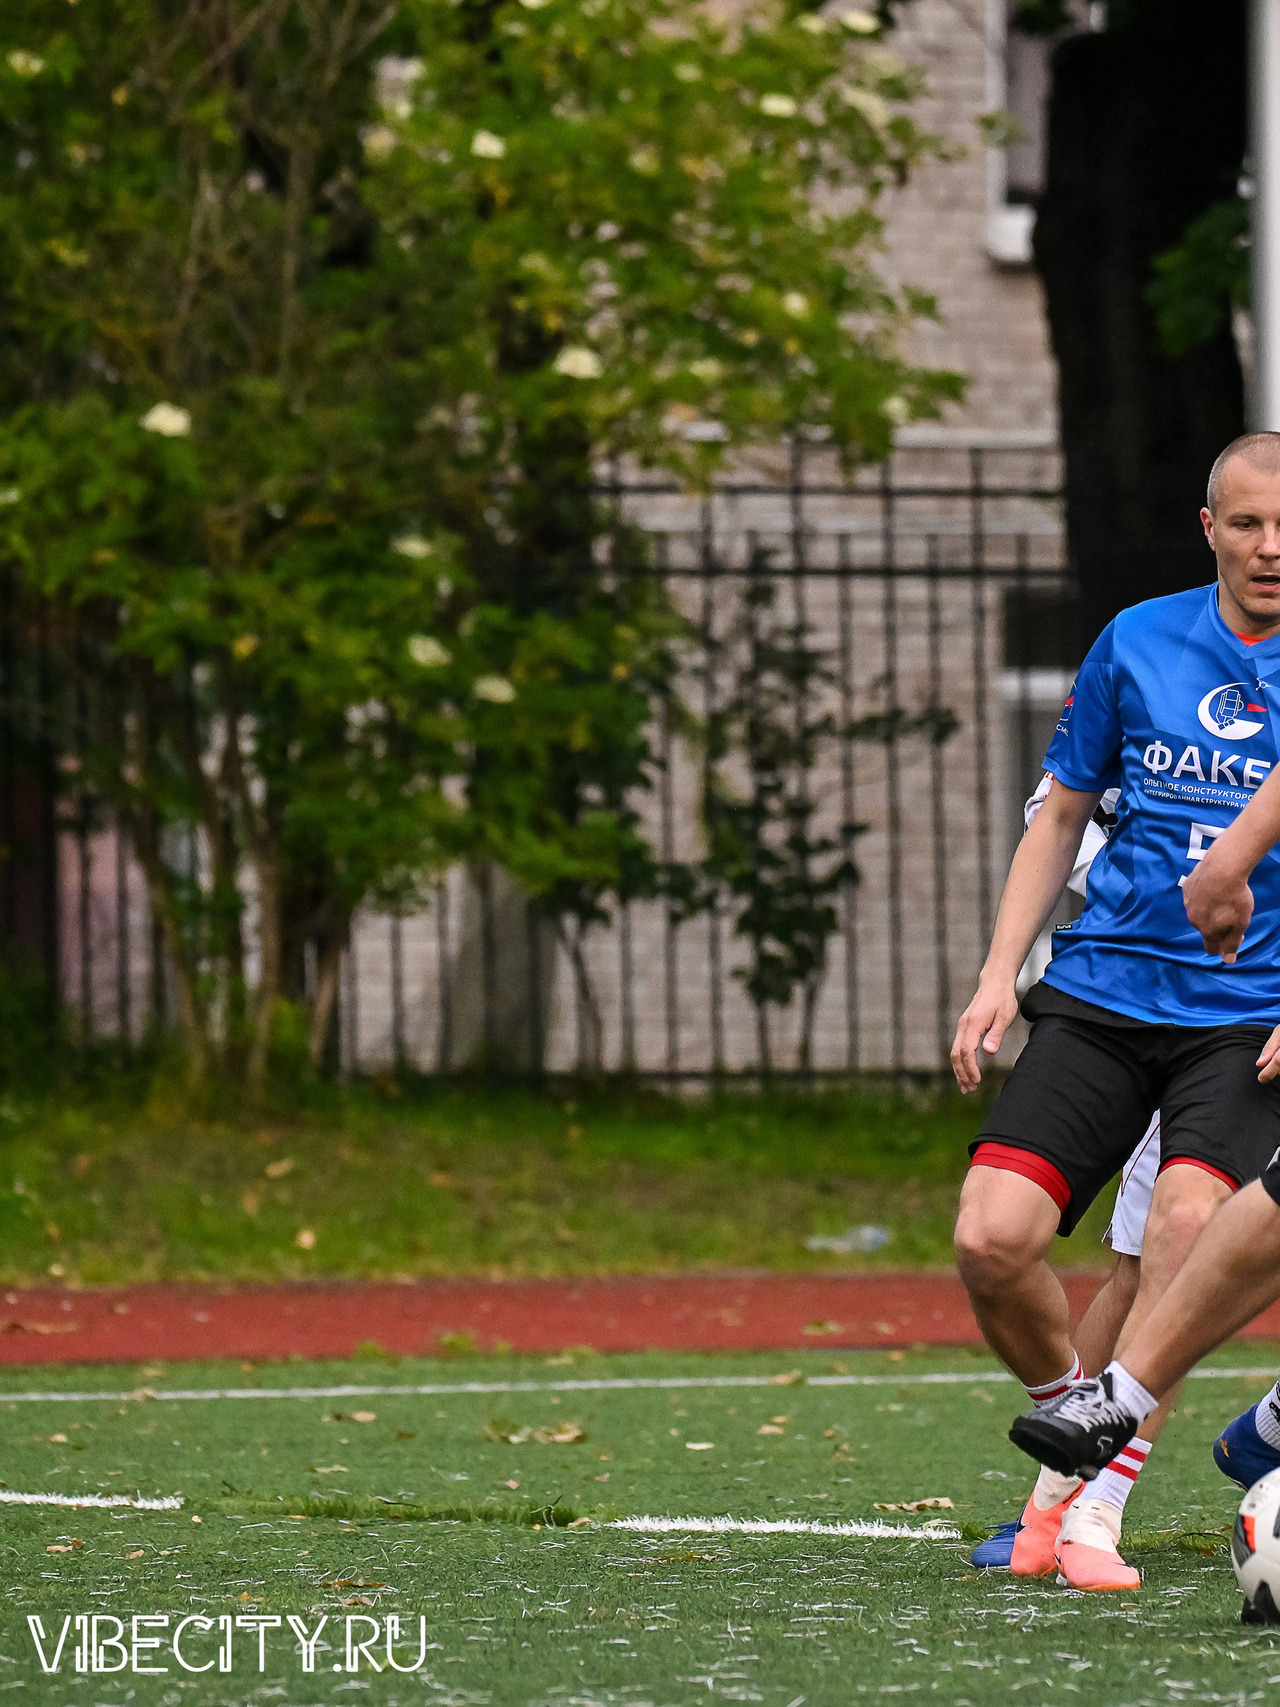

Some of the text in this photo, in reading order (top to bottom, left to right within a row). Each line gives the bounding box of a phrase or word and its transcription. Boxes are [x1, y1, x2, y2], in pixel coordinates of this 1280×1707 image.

[1142, 739, 1272, 790] ФАКЕ
[1181, 785, 1254, 801] КОНСТРУКТОРС
[1201, 797, 1239, 808] СТРУКТУРА
